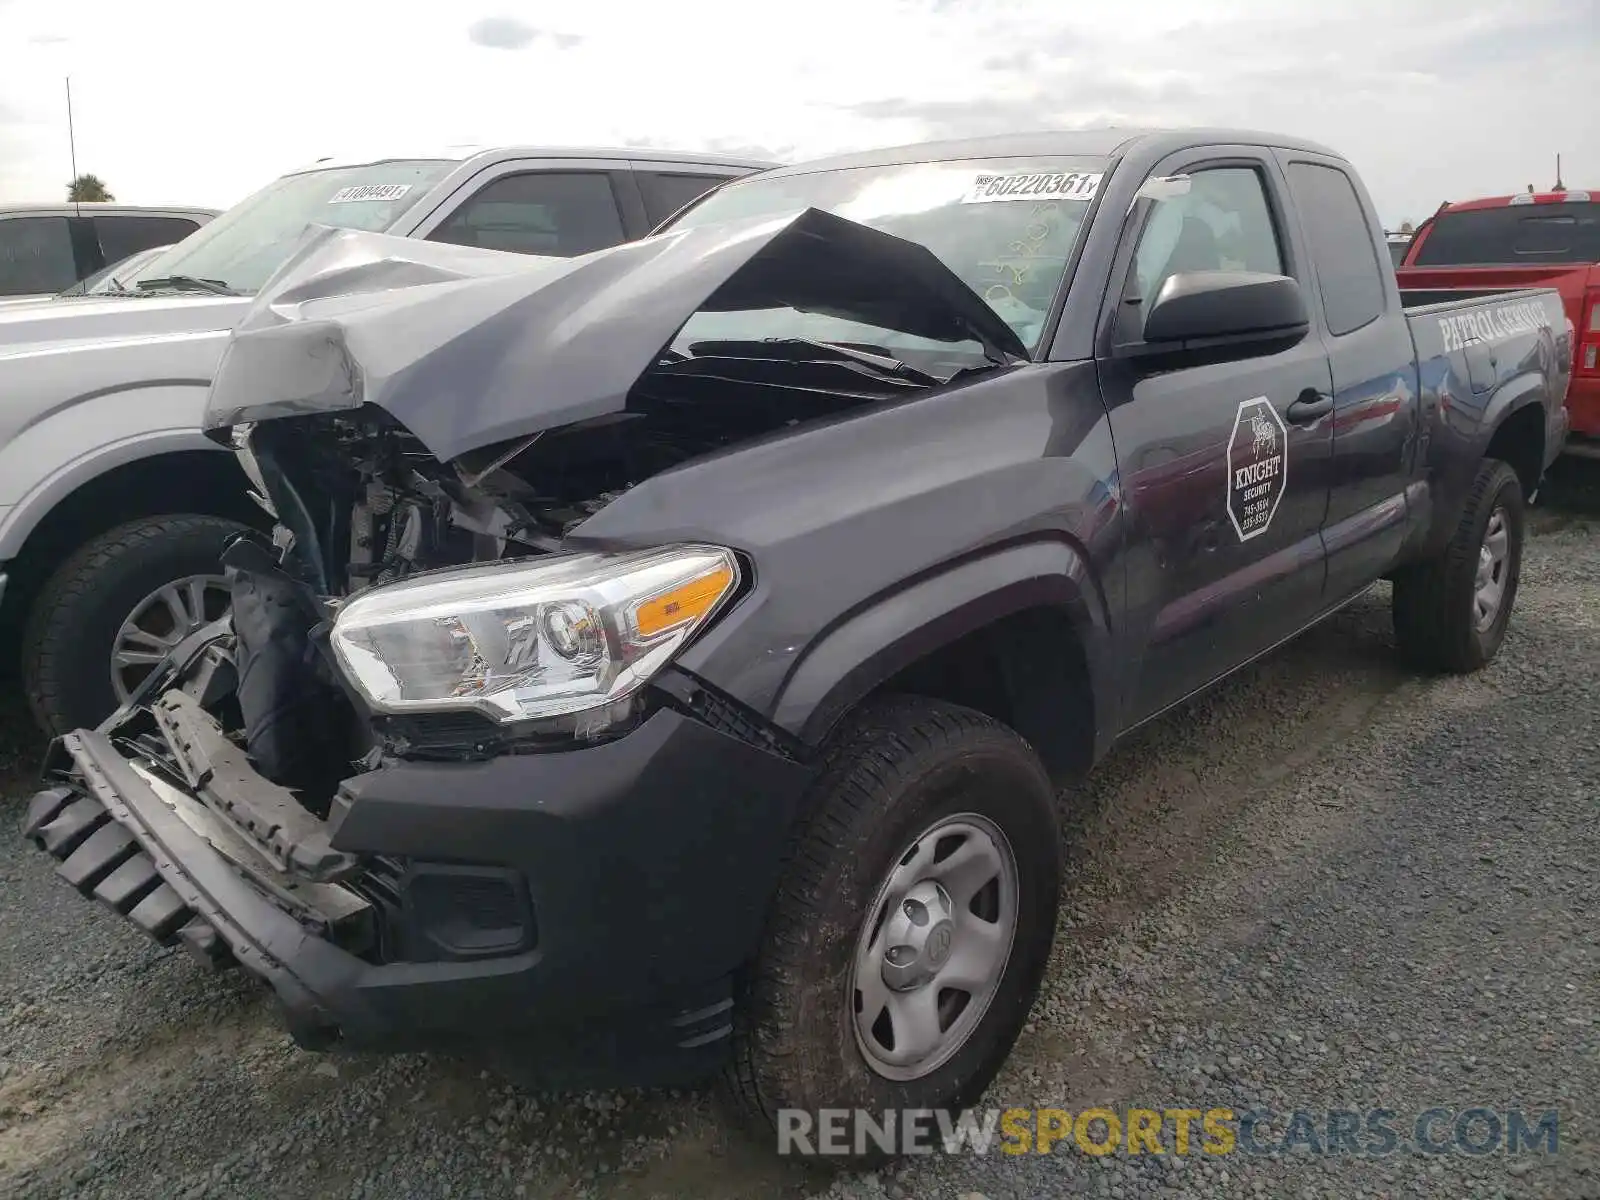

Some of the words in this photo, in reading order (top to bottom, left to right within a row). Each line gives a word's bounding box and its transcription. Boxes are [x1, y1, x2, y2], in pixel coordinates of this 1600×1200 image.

[1438, 310, 1507, 353] PATROL
[1496, 301, 1552, 336] SERVICE
[1235, 455, 1281, 490] KNIGHT
[1243, 482, 1271, 502] SECURITY
